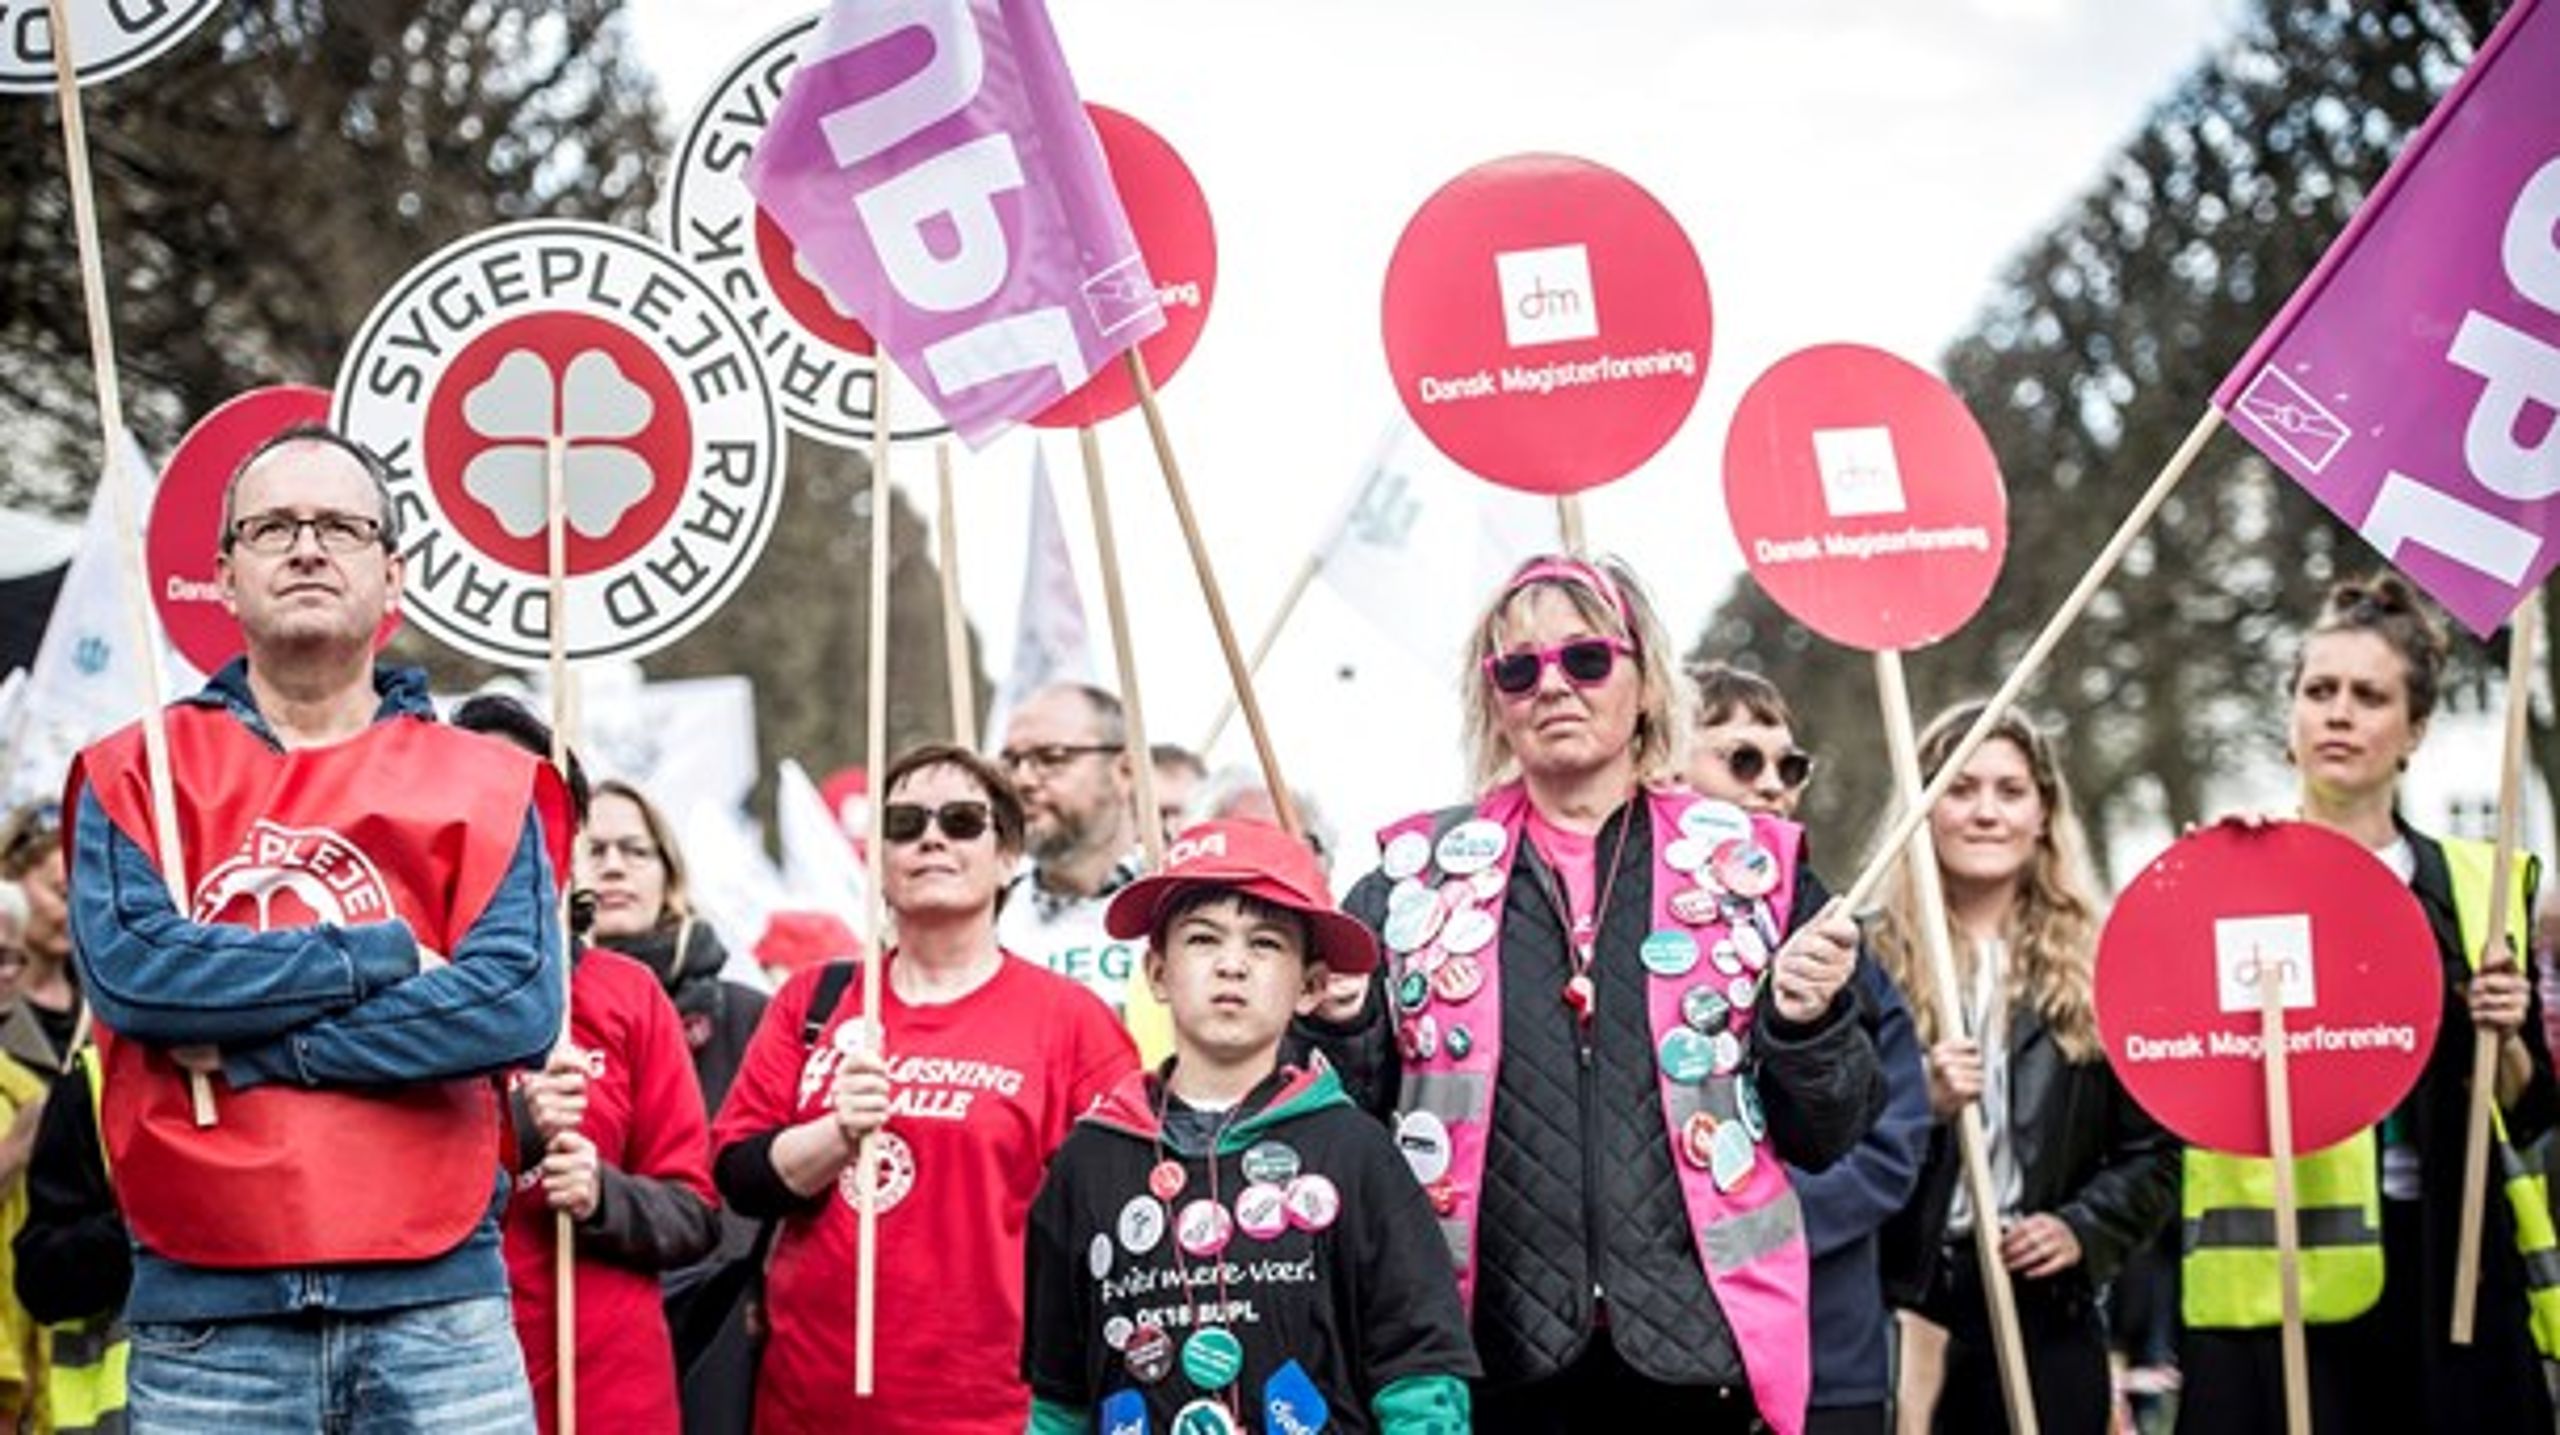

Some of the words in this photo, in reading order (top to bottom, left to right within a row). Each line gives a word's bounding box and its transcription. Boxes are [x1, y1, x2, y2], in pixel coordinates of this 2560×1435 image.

[1419, 370, 1496, 403] Dansk
[1501, 350, 1696, 393] Magisterforening
[368, 246, 750, 404] SYGEPLEJE
[604, 441, 758, 629] RAAD
[1754, 535, 1822, 564] Dansk
[1823, 526, 1990, 560] Magisterforening
[2126, 1034, 2204, 1061] Dansk
[2208, 1024, 2415, 1059] Magerforening
[886, 1088, 974, 1121] ALLE
